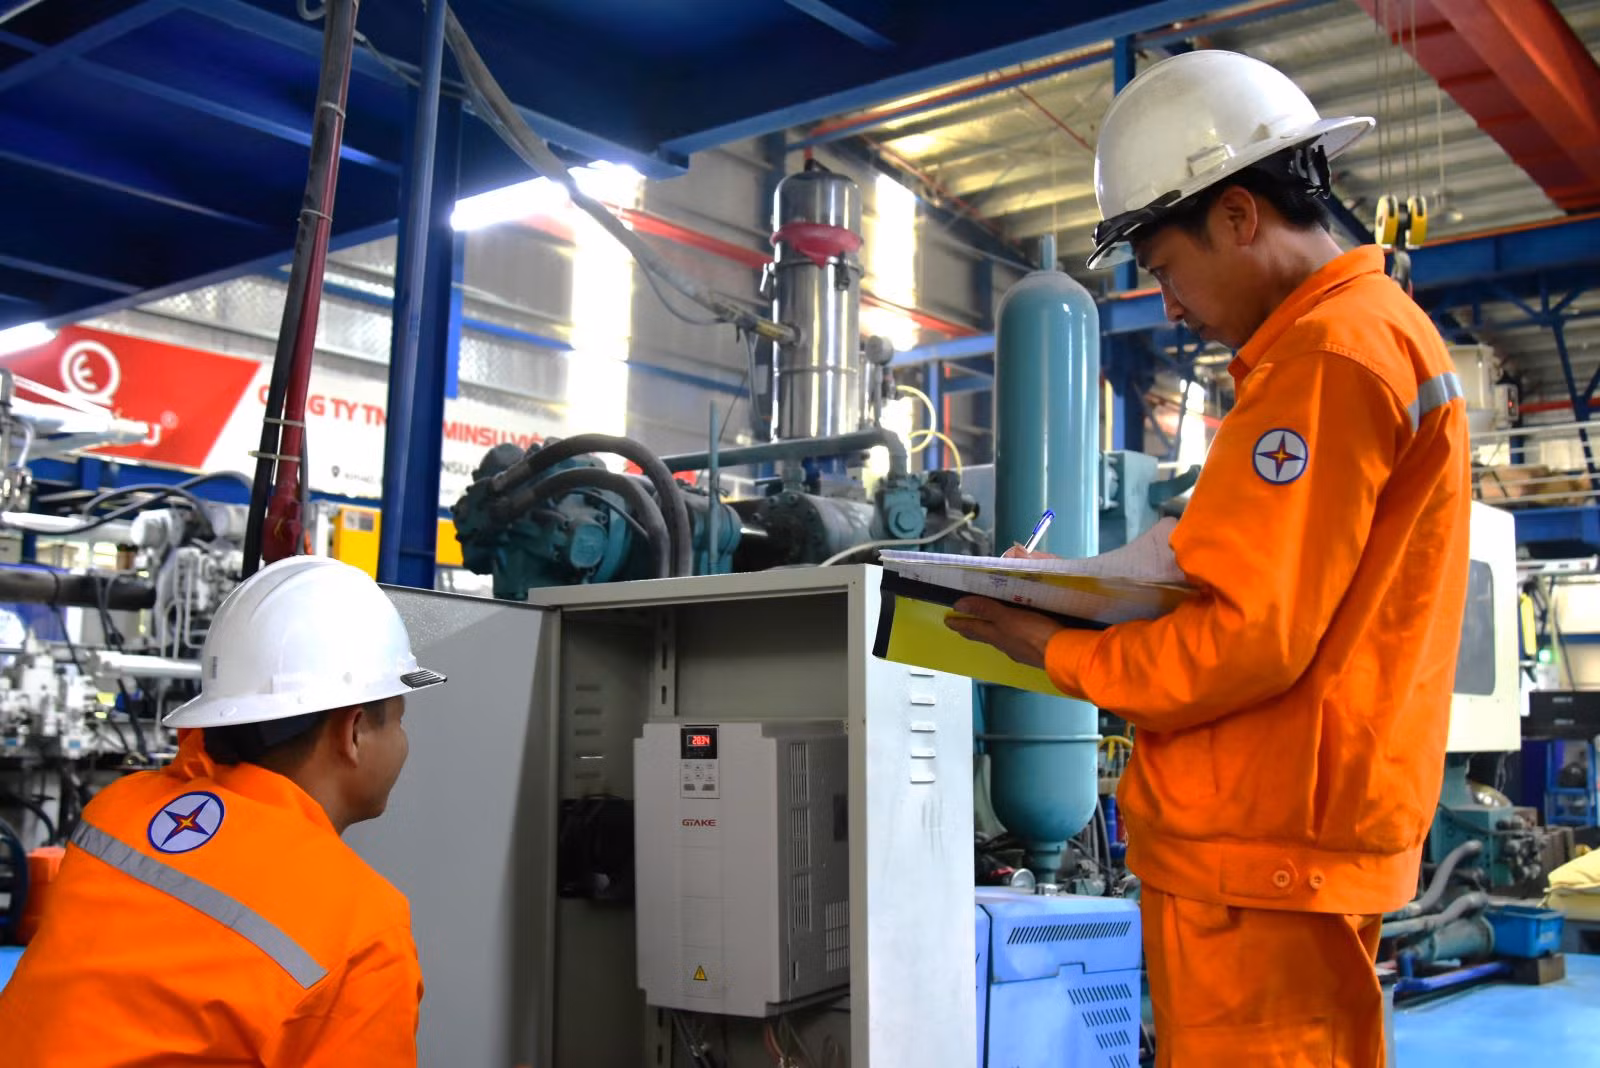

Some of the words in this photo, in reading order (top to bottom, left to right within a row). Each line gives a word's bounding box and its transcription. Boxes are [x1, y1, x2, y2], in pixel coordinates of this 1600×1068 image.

[258, 384, 325, 416] CG
[330, 397, 358, 421] TY
[682, 818, 717, 827] GTAKE
